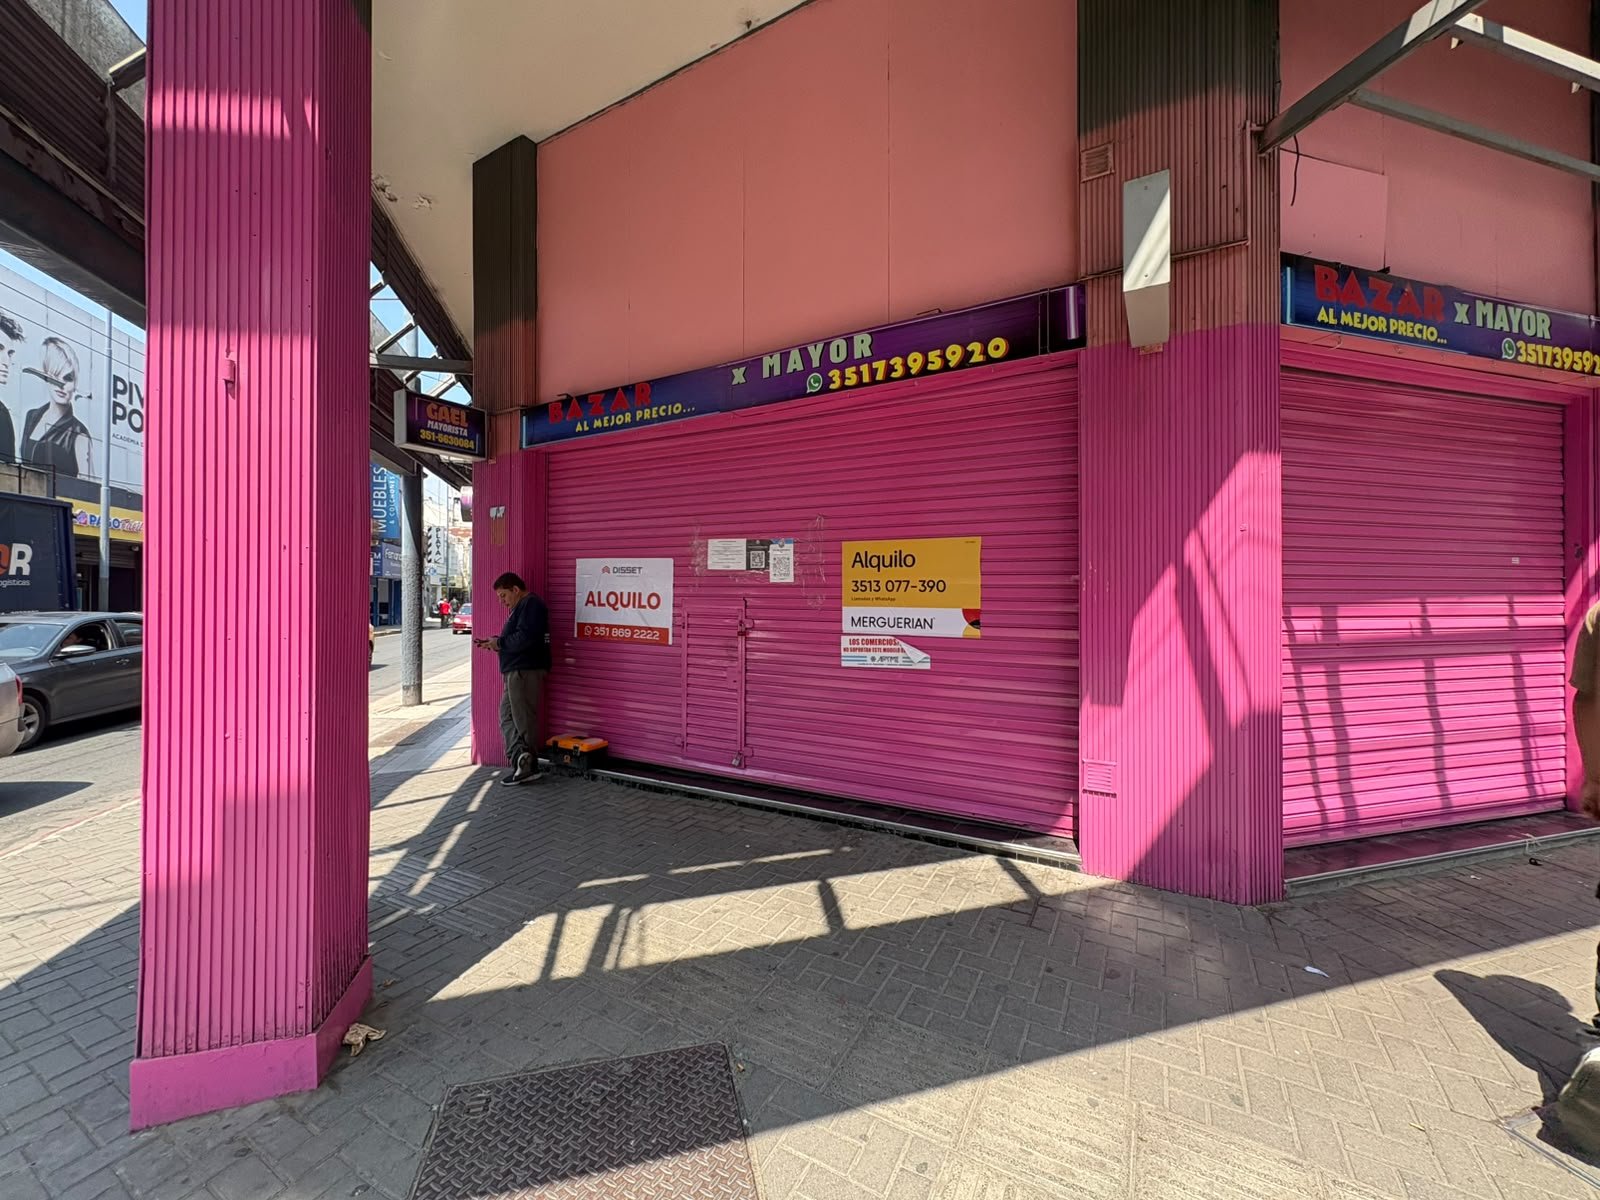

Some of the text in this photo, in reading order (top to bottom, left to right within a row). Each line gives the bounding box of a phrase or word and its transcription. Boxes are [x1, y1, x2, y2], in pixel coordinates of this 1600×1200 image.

[1314, 264, 1445, 324] BAZAR
[1475, 299, 1552, 340] MAYOR
[1317, 306, 1338, 326] AL
[1340, 310, 1388, 334] MEJOR
[762, 333, 873, 379] MAYOR
[827, 337, 1009, 390] 3517395920
[548, 382, 652, 424] BAZAR
[426, 403, 468, 427] GAEL
[575, 421, 590, 433] AL
[593, 411, 632, 430] MEJOR
[112, 433, 139, 445] ACADEMIA
[427, 420, 468, 437] MAYORISTA
[372, 466, 388, 533] MUEBLES
[612, 566, 643, 574] DISSET
[851, 549, 916, 572] Alquilo
[851, 579, 947, 593] 3513 077-390
[584, 590, 662, 612] ALQUILO
[593, 626, 660, 640] 351 869 2222
[851, 616, 934, 630] MERGUERIAN
[849, 638, 860, 646] LOS
